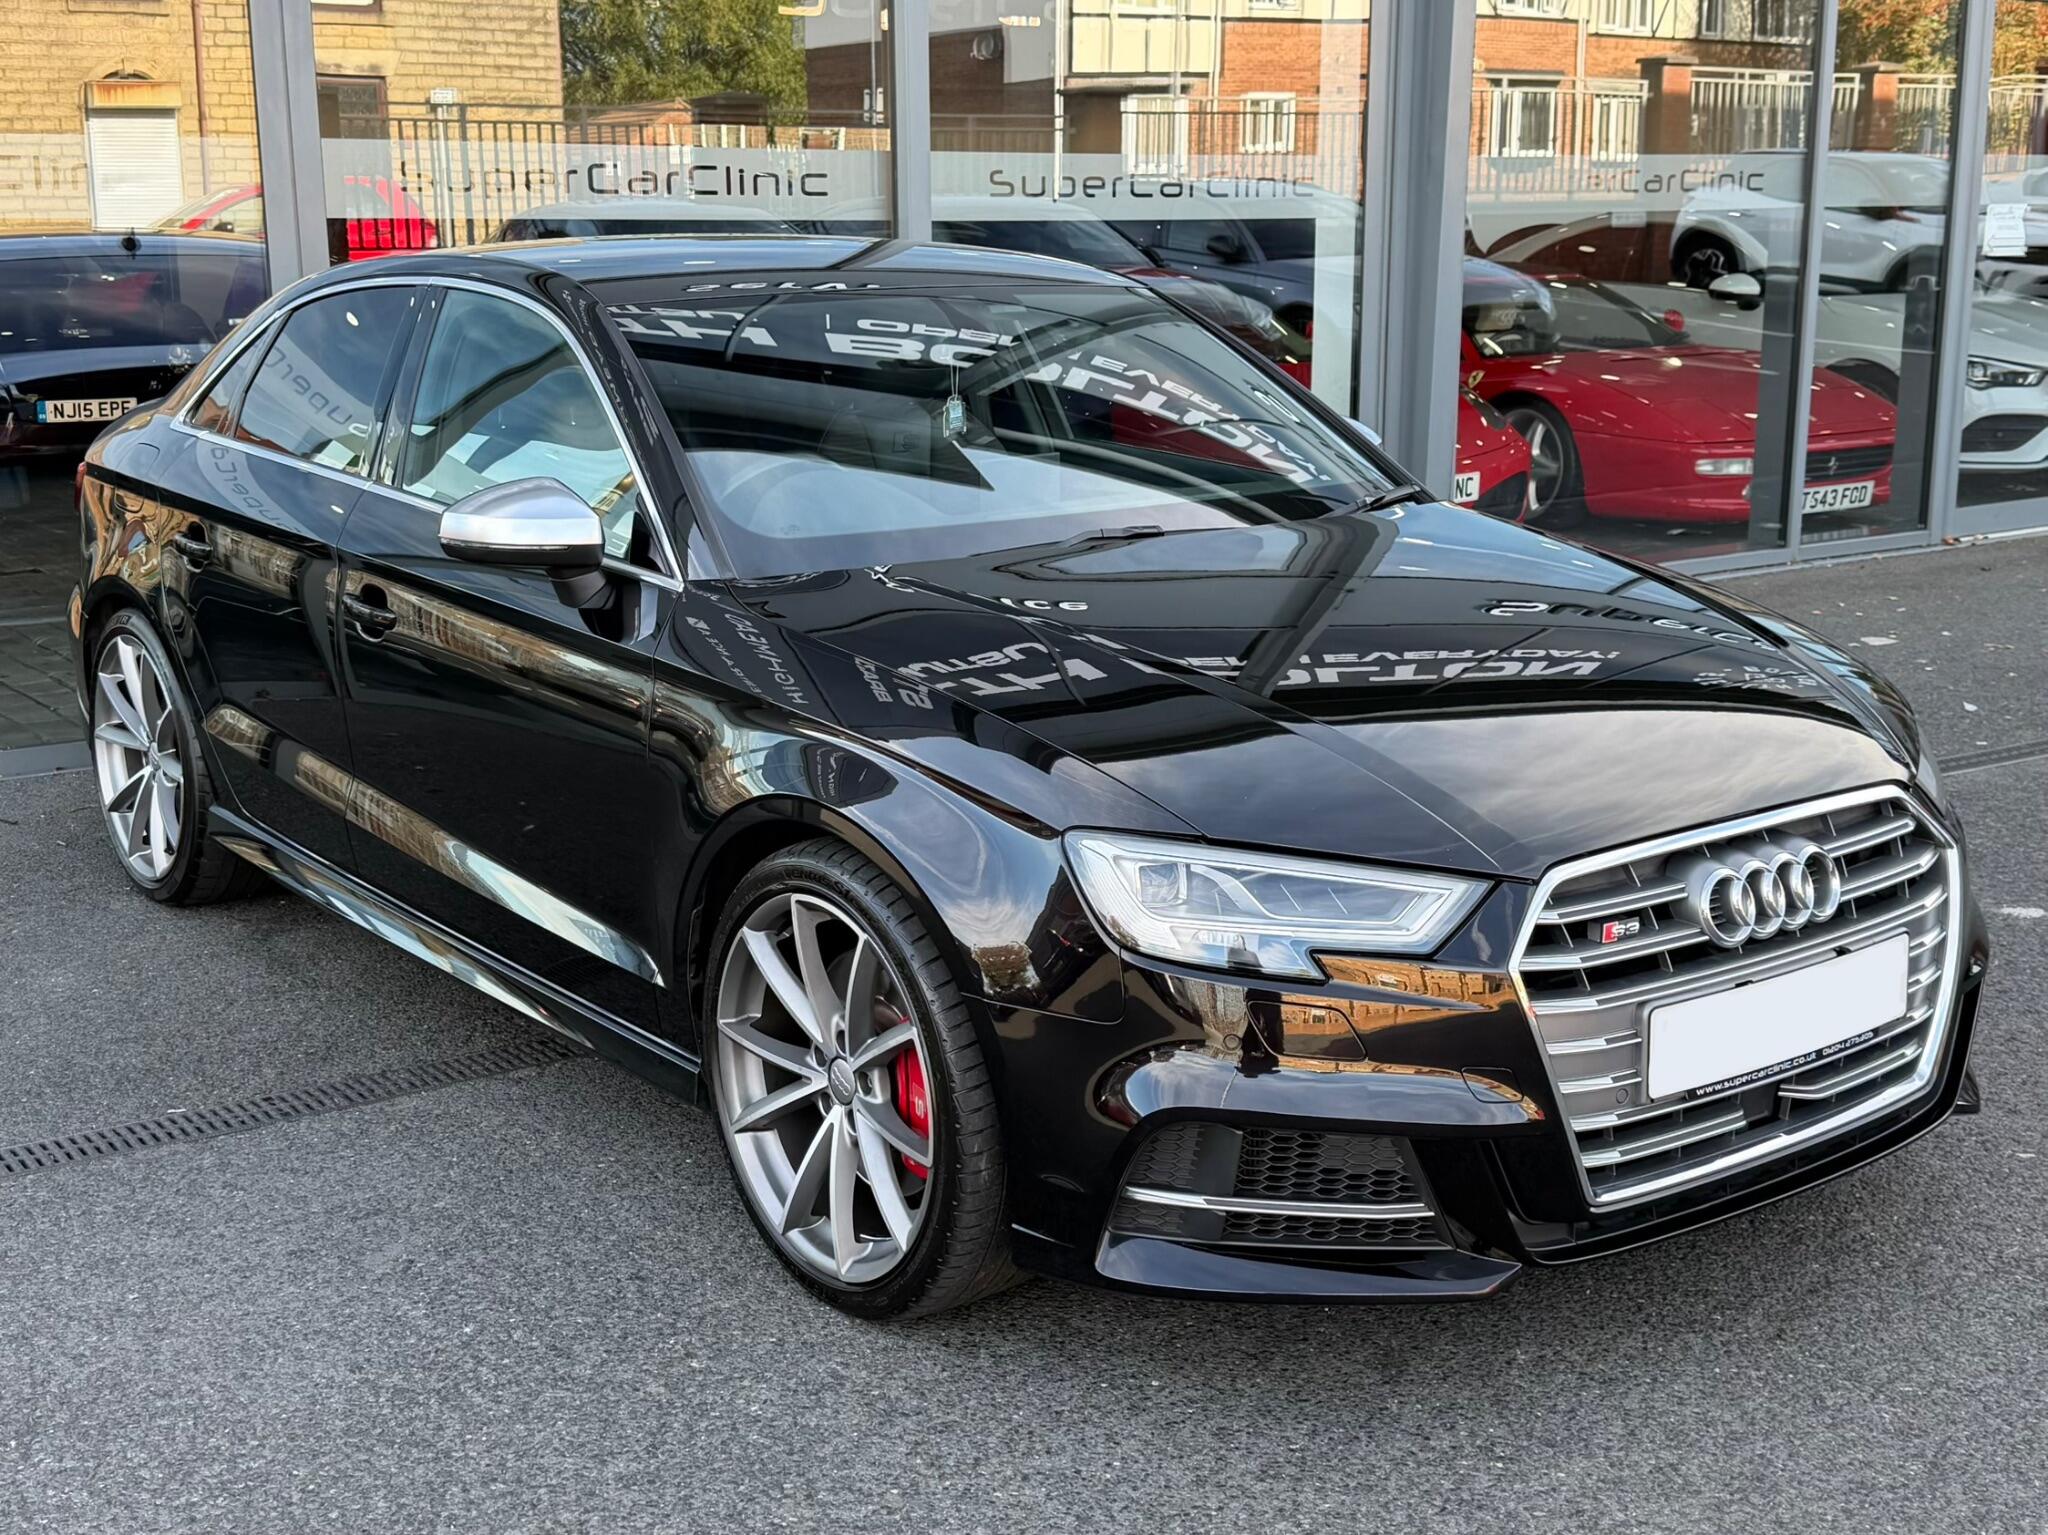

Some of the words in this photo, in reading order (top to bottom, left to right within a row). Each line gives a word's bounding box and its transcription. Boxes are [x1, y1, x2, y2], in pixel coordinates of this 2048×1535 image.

[990, 170, 1314, 198] SuperCarClinic
[53, 402, 93, 419] NJ15
[1610, 921, 1640, 937] S3
[1695, 1052, 1817, 1097] www.supercarclinic.co.uk
